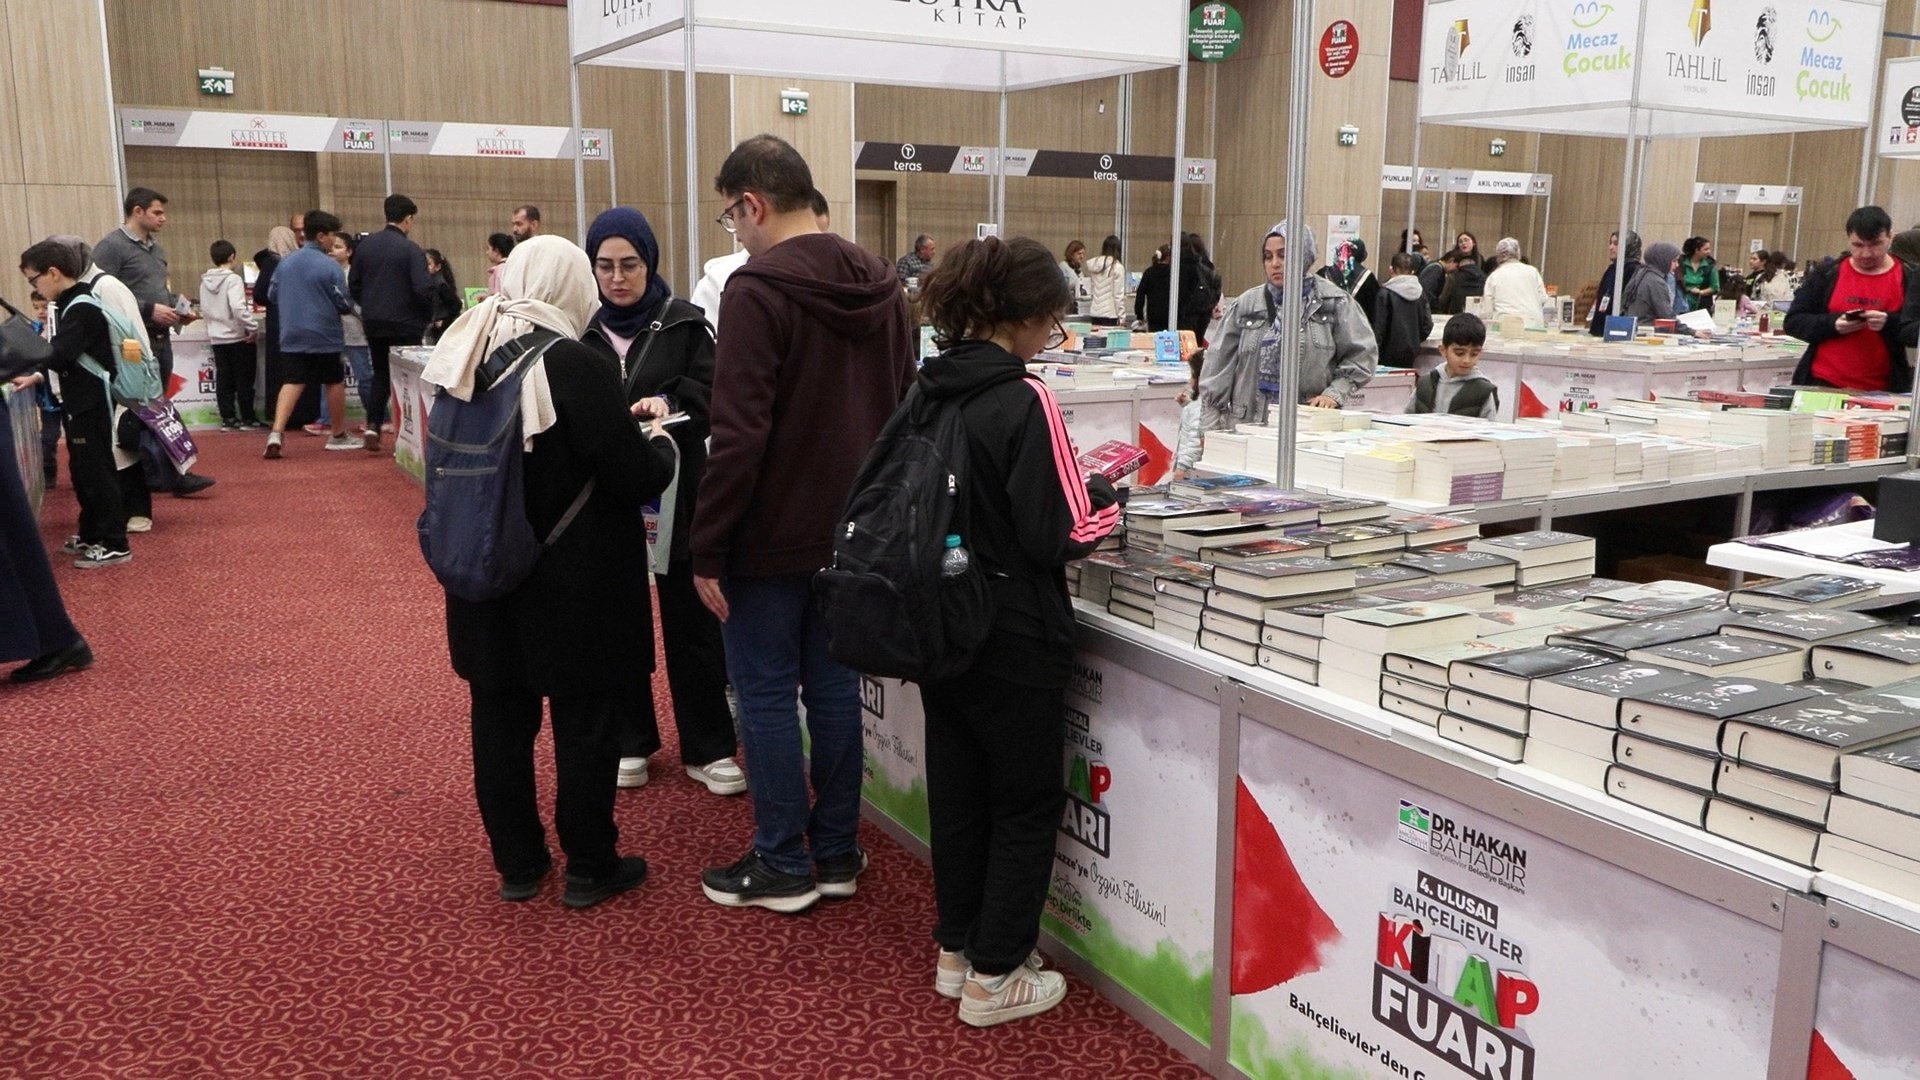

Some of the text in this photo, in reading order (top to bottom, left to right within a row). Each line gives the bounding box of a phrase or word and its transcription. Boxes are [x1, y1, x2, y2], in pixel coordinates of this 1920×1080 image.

[1562, 45, 1632, 78] Çocuk
[1567, 33, 1619, 51] Mecaz
[1801, 46, 1843, 71] Mecaz
[1795, 70, 1852, 103] Çocuk
[344, 140, 374, 150] FUARI
[894, 160, 922, 172] teras
[1093, 170, 1118, 181] teras
[1062, 797, 1106, 851] ARI
[1431, 812, 1459, 840] DR.
[1462, 825, 1527, 868] HAKAN
[1430, 829, 1526, 888] BAHADIR
[1090, 857, 1123, 900] Özgür
[1122, 879, 1167, 927] Filistin!
[1419, 876, 1496, 925] 4. ULUSAL
[1377, 911, 1540, 1030] KİTAP
[1380, 973, 1525, 1080] FUARI
